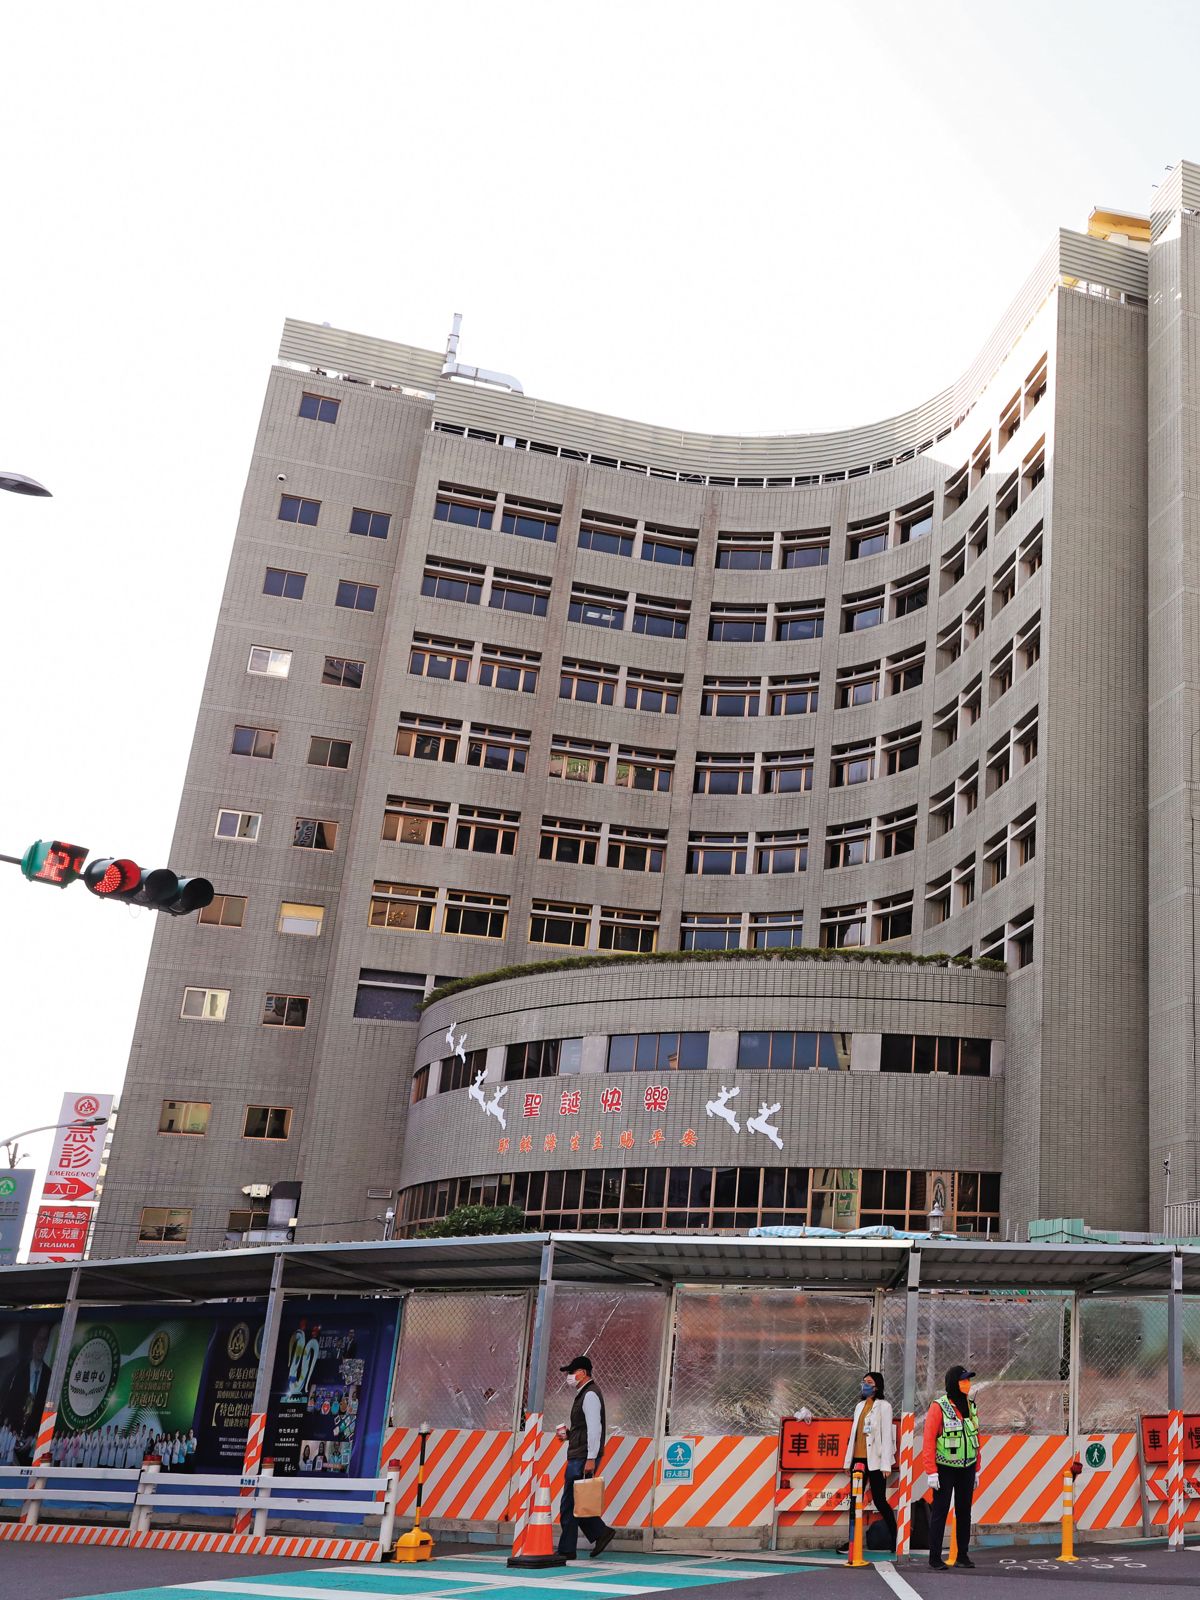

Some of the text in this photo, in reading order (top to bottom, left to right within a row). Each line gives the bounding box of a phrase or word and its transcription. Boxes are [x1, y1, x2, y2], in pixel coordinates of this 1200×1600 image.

[523, 1085, 669, 1118] 聖誕快樂
[58, 1118, 98, 1169] 急診
[49, 1170, 96, 1178] EMERGENCY
[52, 1184, 79, 1195] 入口
[39, 1211, 88, 1224] 外傷急診
[74, 1370, 106, 1383] 卓越中心
